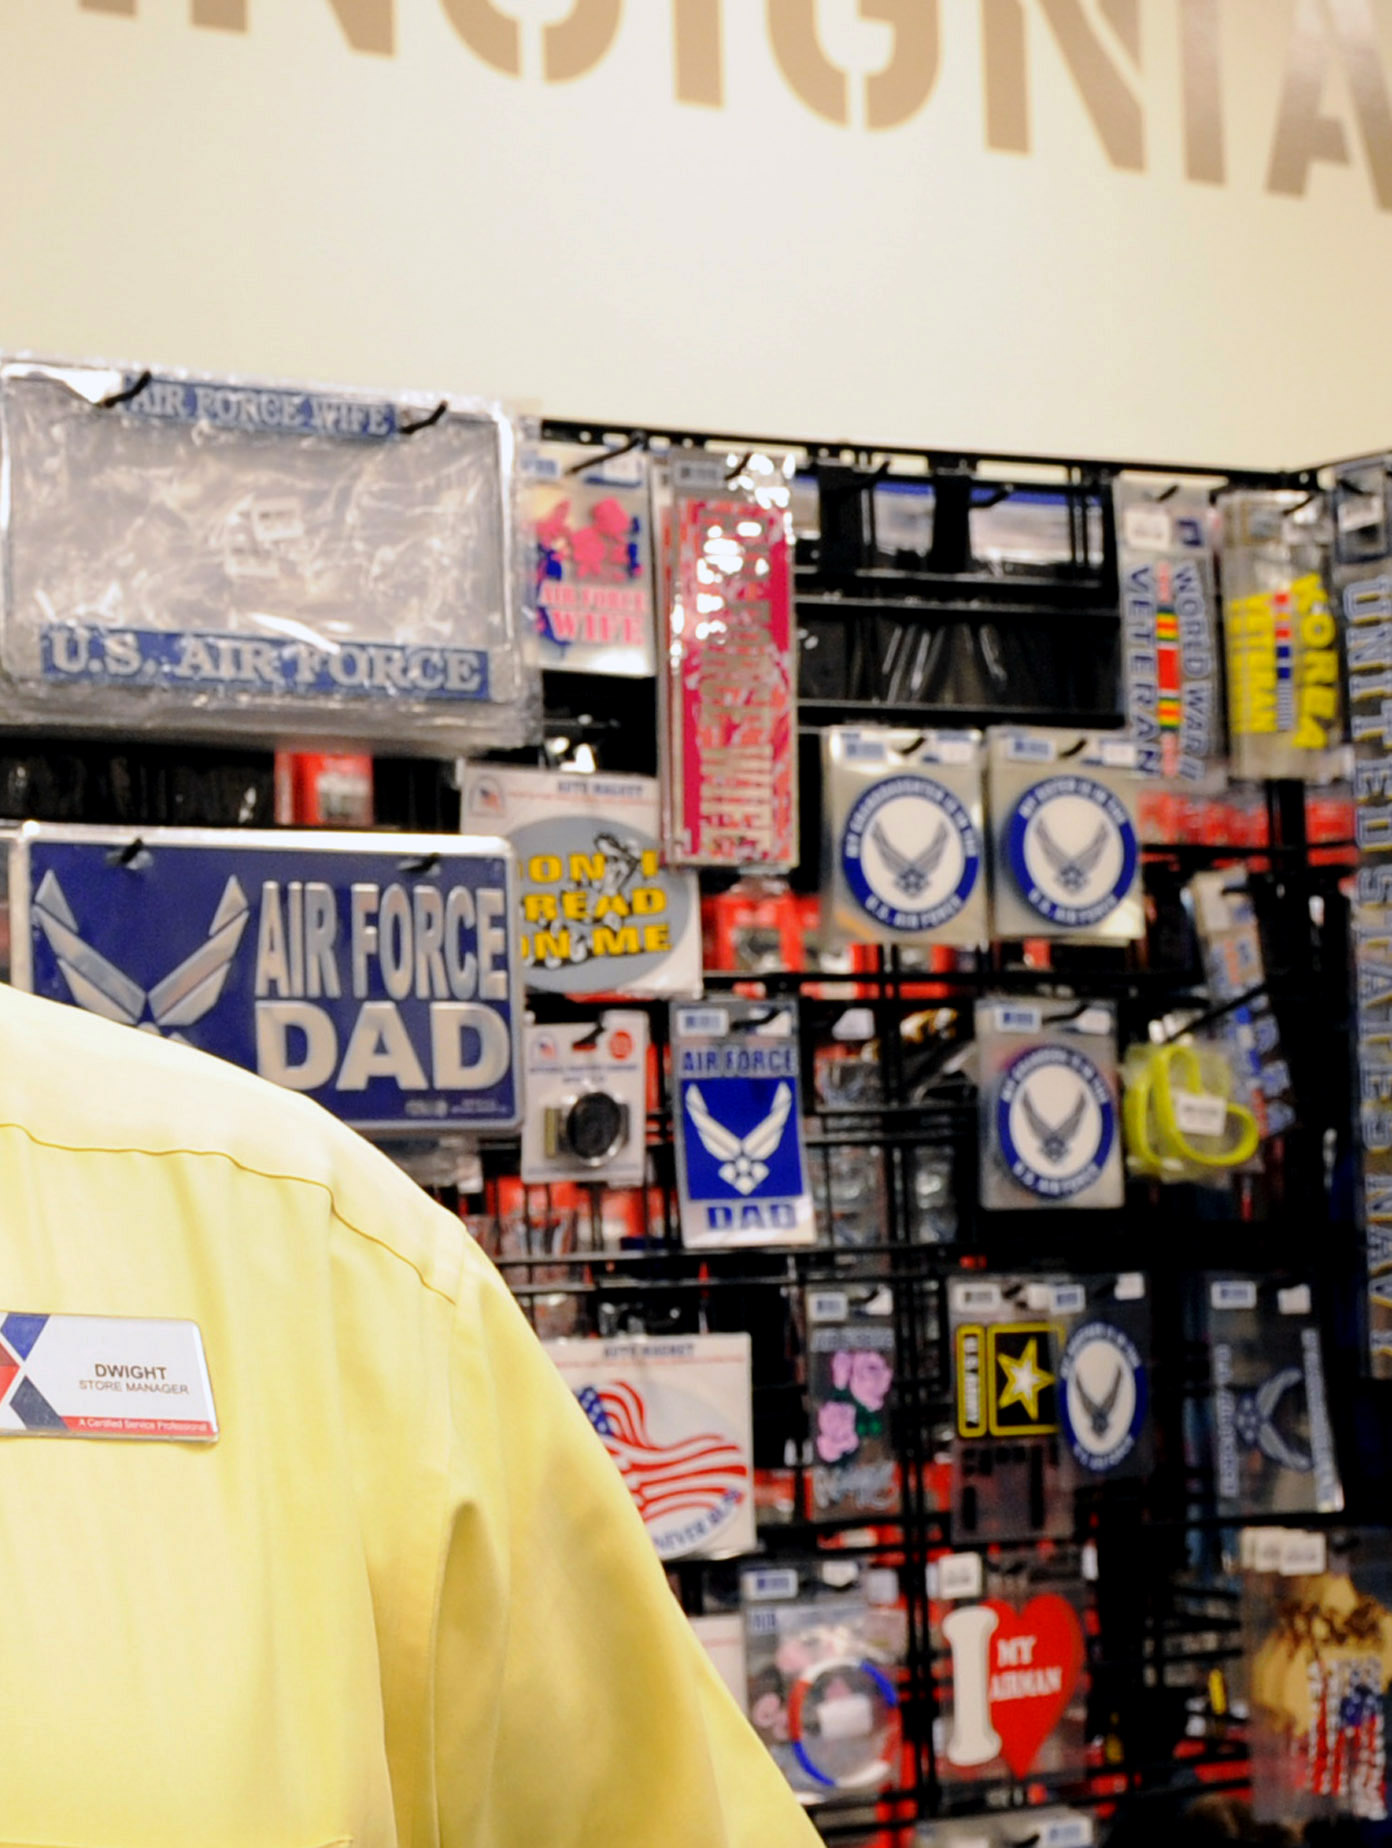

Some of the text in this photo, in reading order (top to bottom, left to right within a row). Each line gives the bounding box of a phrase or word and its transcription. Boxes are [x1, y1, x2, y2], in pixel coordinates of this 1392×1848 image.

[133, 386, 391, 436] AIR FORCE WIFE
[552, 609, 645, 645] WIFE
[1174, 565, 1207, 676] WORLD
[50, 629, 482, 692] U.S. AIR FORCE
[1129, 565, 1161, 776] VETERAN
[1290, 573, 1339, 748] KOREA
[255, 880, 509, 1000] AIR FORCE
[592, 922, 672, 957] ME
[255, 1000, 510, 1092] DAD
[683, 1050, 793, 1072] AIR FORCE
[707, 1203, 797, 1230] DAD
[78, 1379, 190, 1395] STORE MANAGER
[94, 1363, 167, 1380] DWIGHT
[87, 1418, 123, 1430] Certified
[124, 1419, 156, 1431] Service
[157, 1420, 207, 1433] Professional
[996, 1634, 1037, 1668] MY
